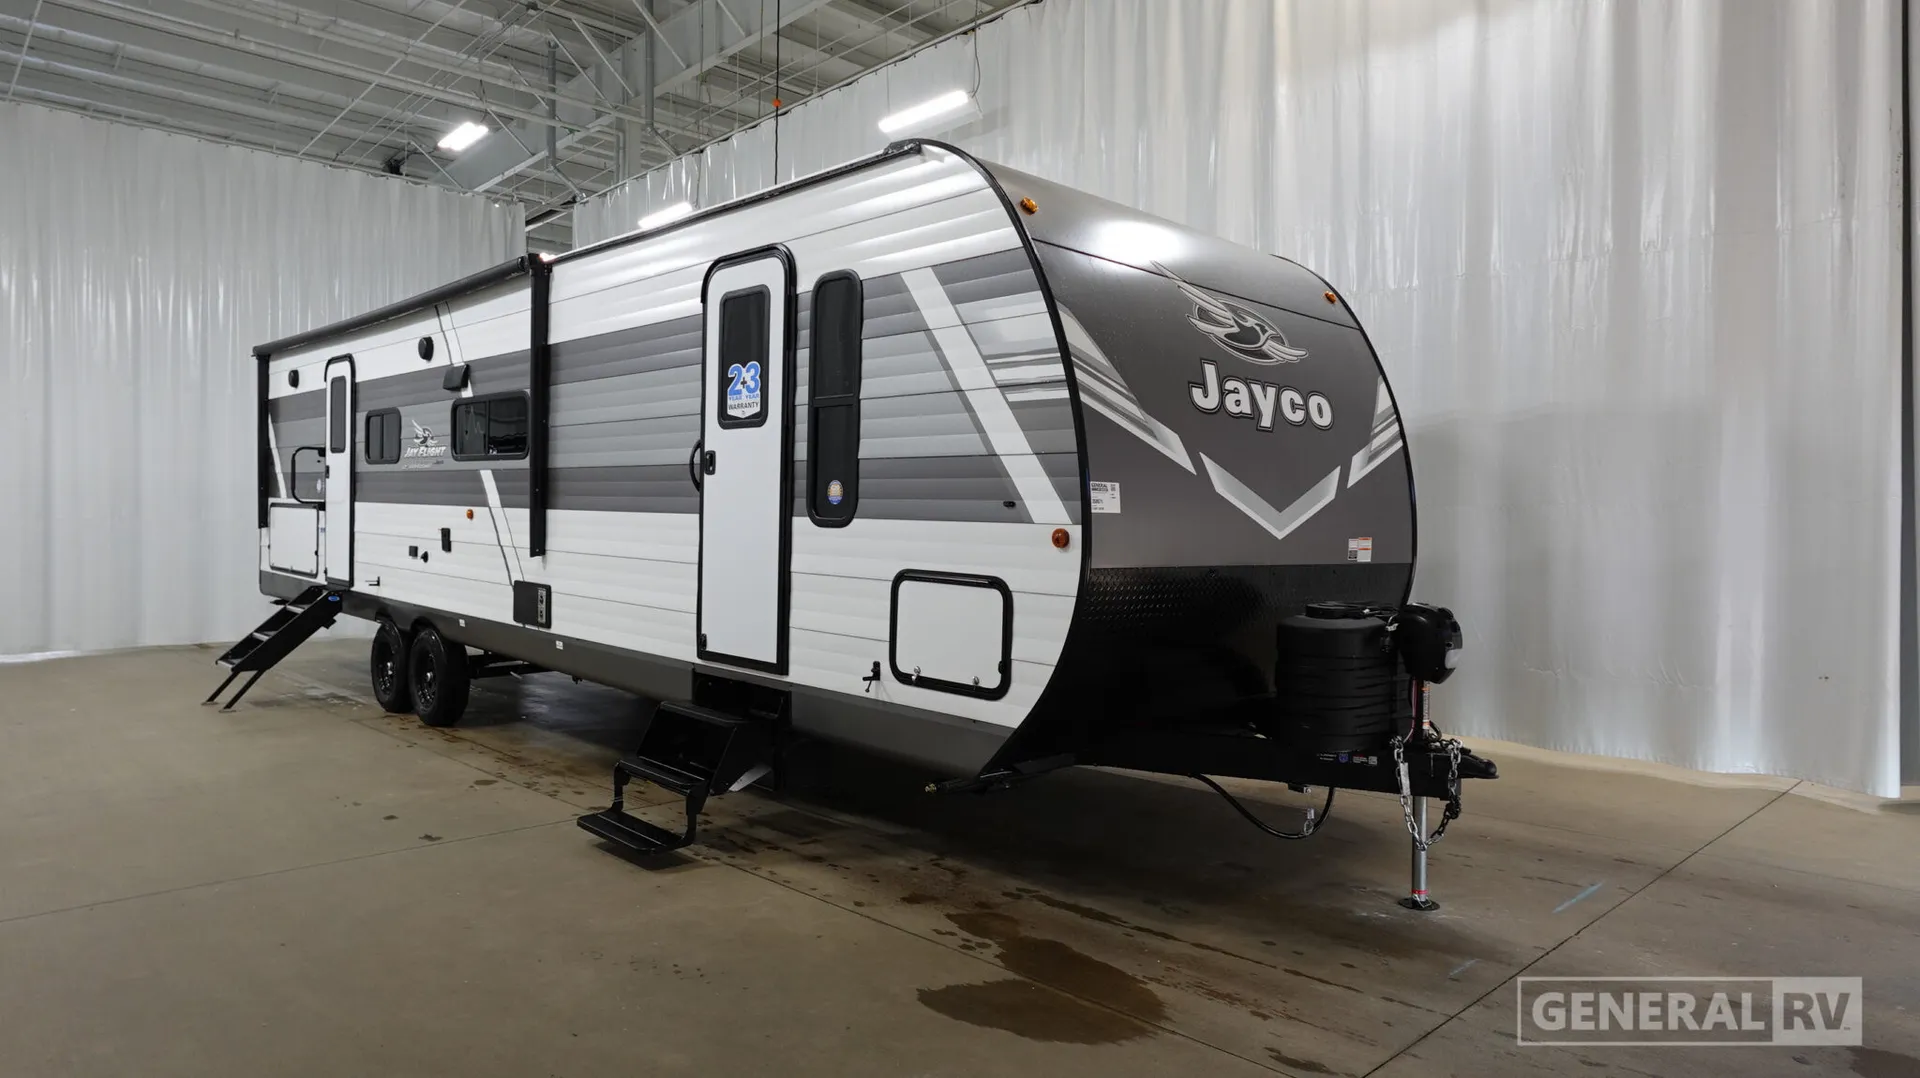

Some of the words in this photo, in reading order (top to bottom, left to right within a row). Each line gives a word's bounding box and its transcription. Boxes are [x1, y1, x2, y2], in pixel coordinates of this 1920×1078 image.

[1189, 360, 1334, 431] Jayco
[728, 401, 759, 410] WARRANTY
[404, 447, 420, 458] JAY
[418, 446, 447, 457] FLIGHT
